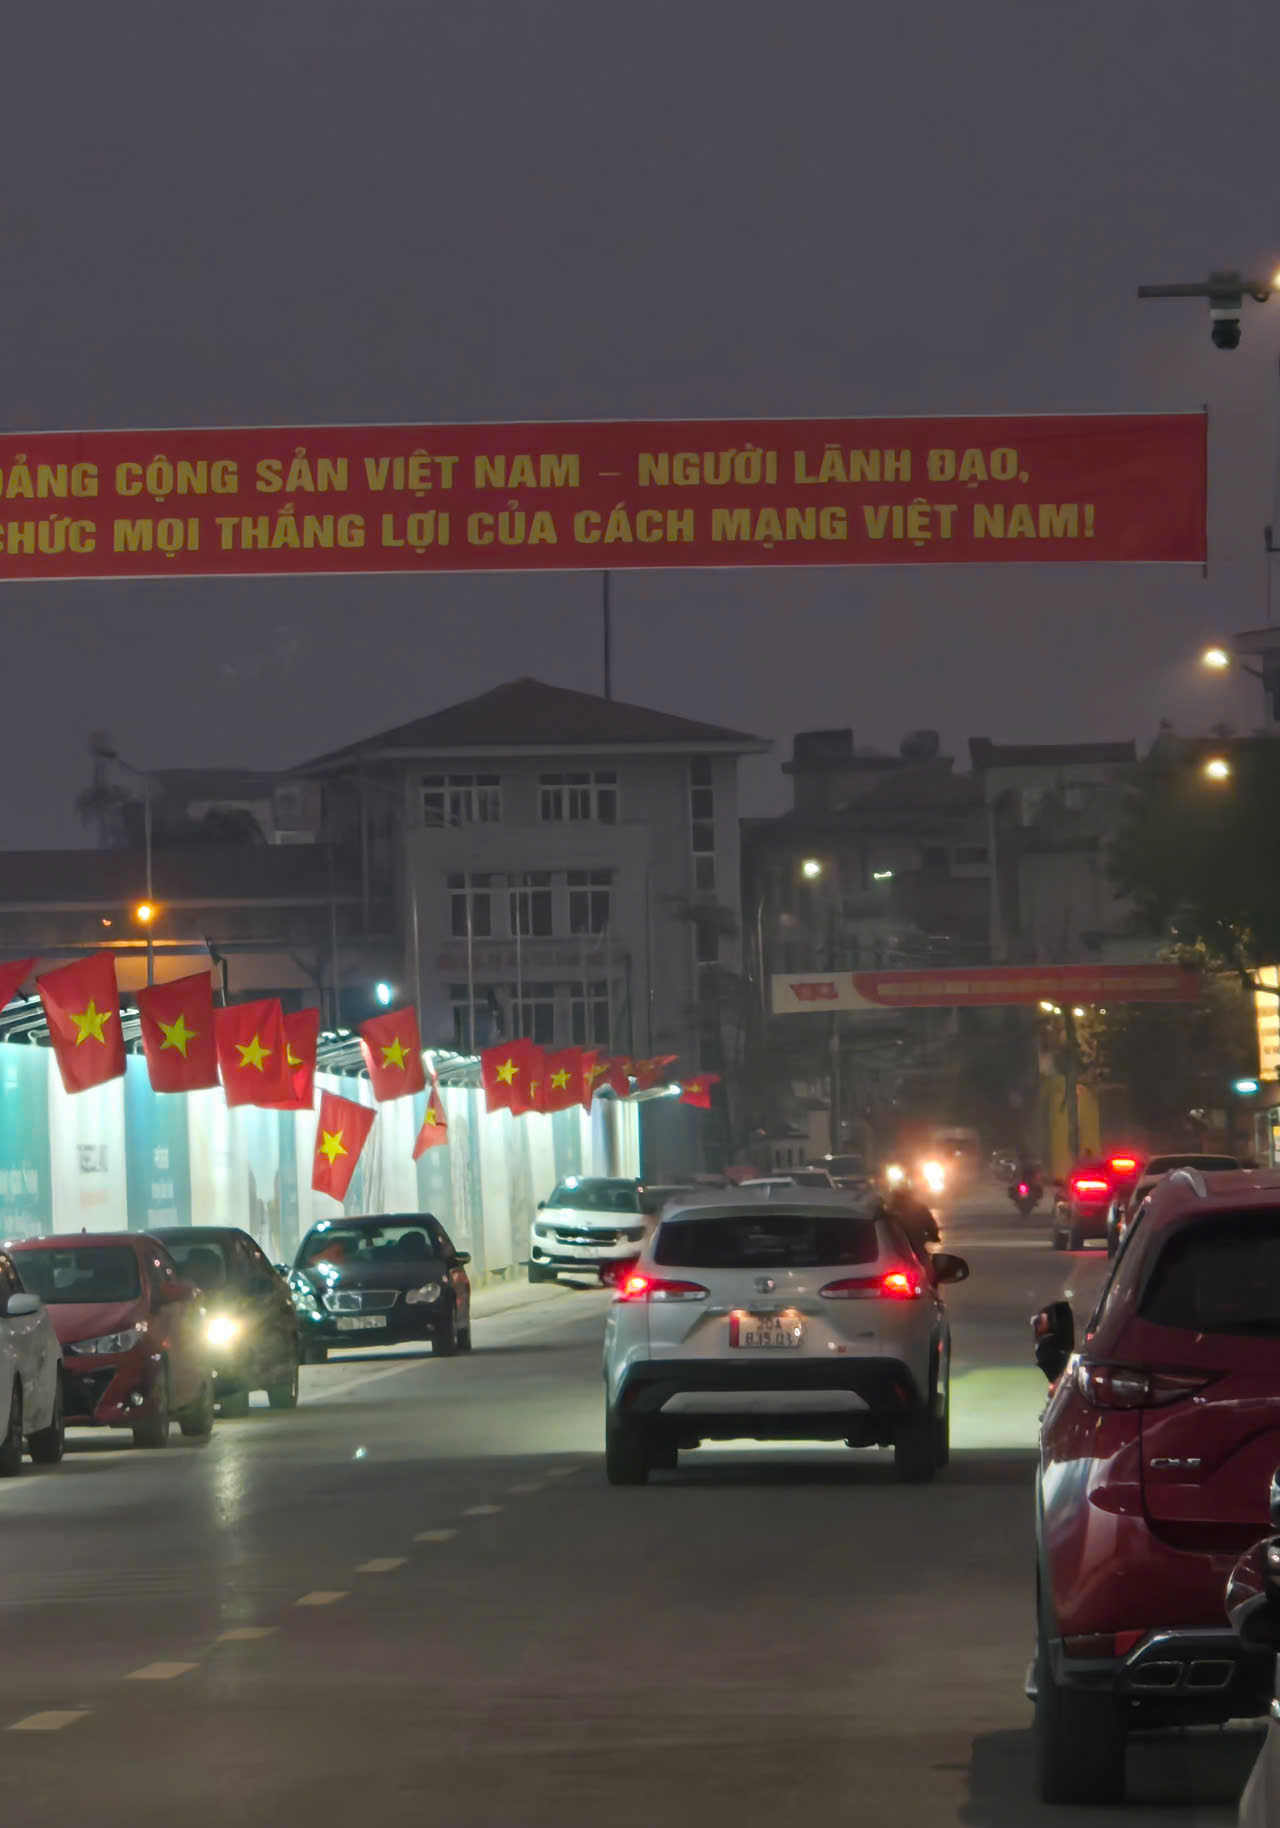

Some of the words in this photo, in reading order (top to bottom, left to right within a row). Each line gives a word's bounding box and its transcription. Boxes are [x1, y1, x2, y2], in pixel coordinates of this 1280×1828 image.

[115, 454, 238, 502] CỘNG
[255, 446, 349, 493] SẢN
[364, 448, 459, 497] VIỆT
[474, 454, 580, 489] NAM
[637, 442, 777, 487] NGƯỜI
[793, 443, 912, 484] LÃNH
[927, 447, 1030, 488] ĐẠO,
[113, 517, 200, 558] MỌI
[215, 501, 366, 550] THẮNG
[381, 509, 451, 554] LỢI
[466, 499, 557, 546] CỦA
[573, 501, 694, 544] CÁCH
[711, 506, 848, 549] MẠNG
[863, 497, 959, 547] VIỆT
[972, 503, 1096, 539] NAM!
